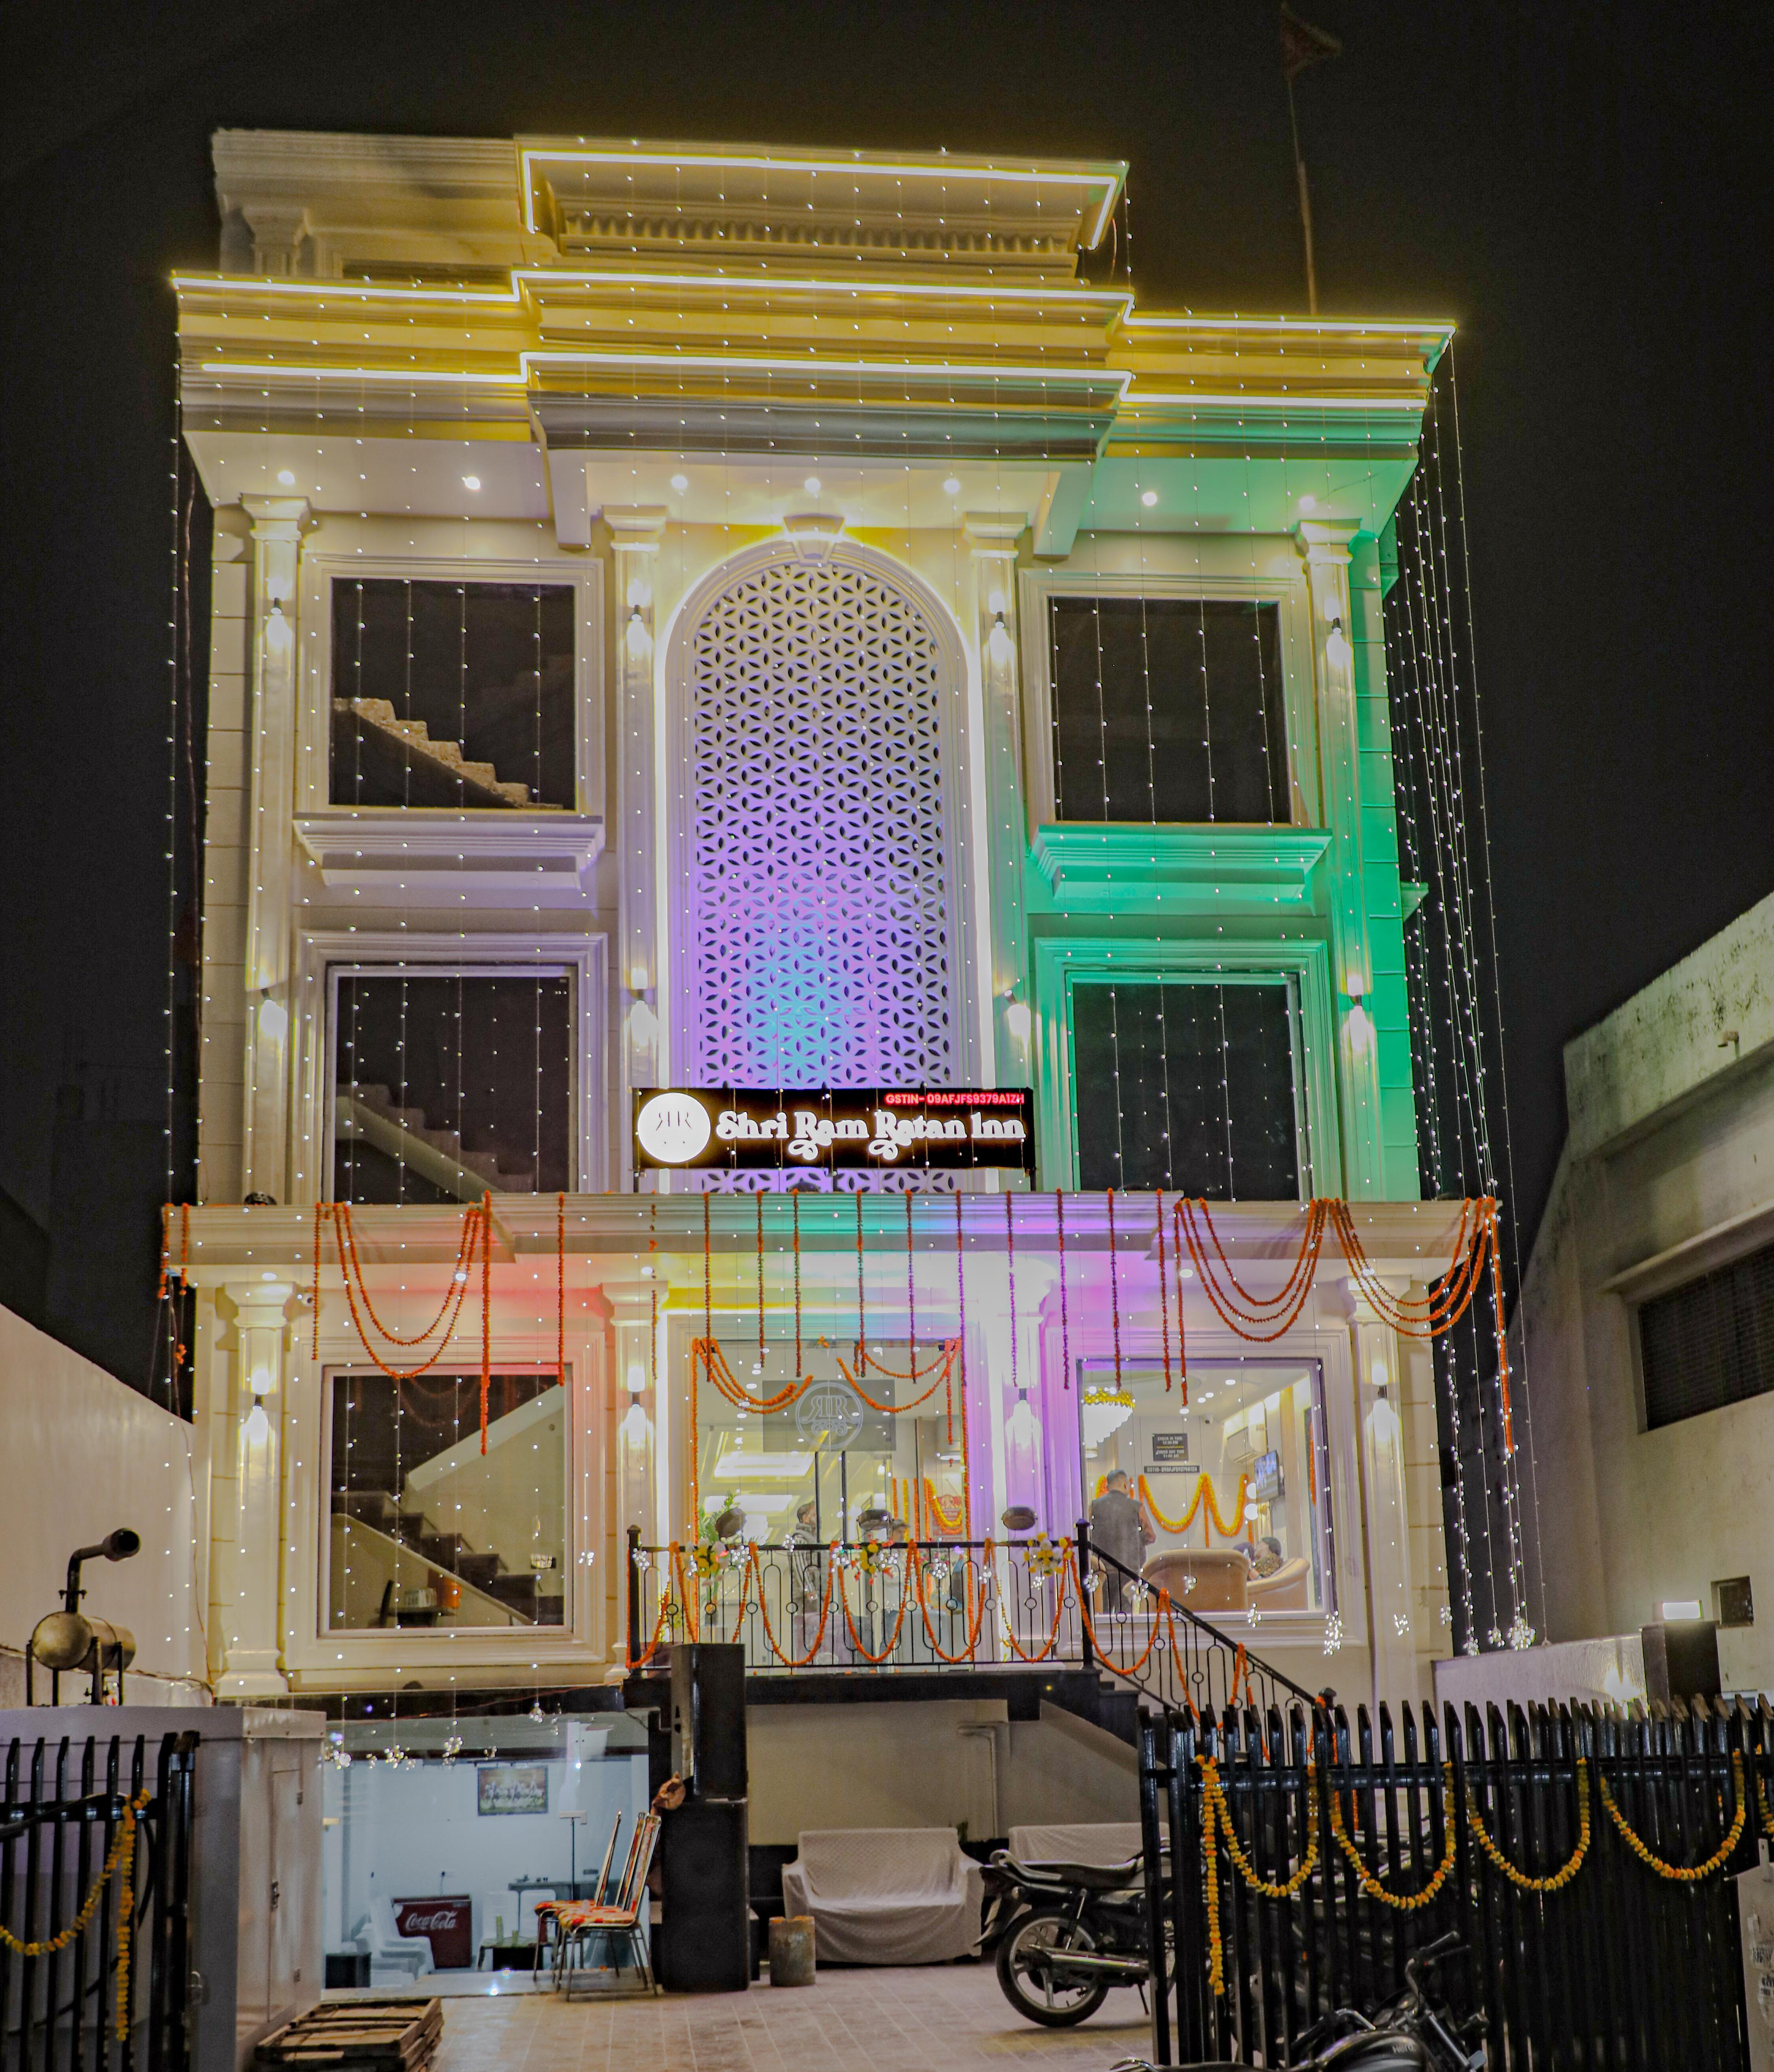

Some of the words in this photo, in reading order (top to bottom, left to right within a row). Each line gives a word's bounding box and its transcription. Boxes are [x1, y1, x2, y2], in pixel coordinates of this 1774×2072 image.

[716, 1110, 789, 1139] Shri
[788, 1110, 870, 1160] Ram
[869, 1109, 968, 1160] Ratan
[970, 1112, 1027, 1138] Inn
